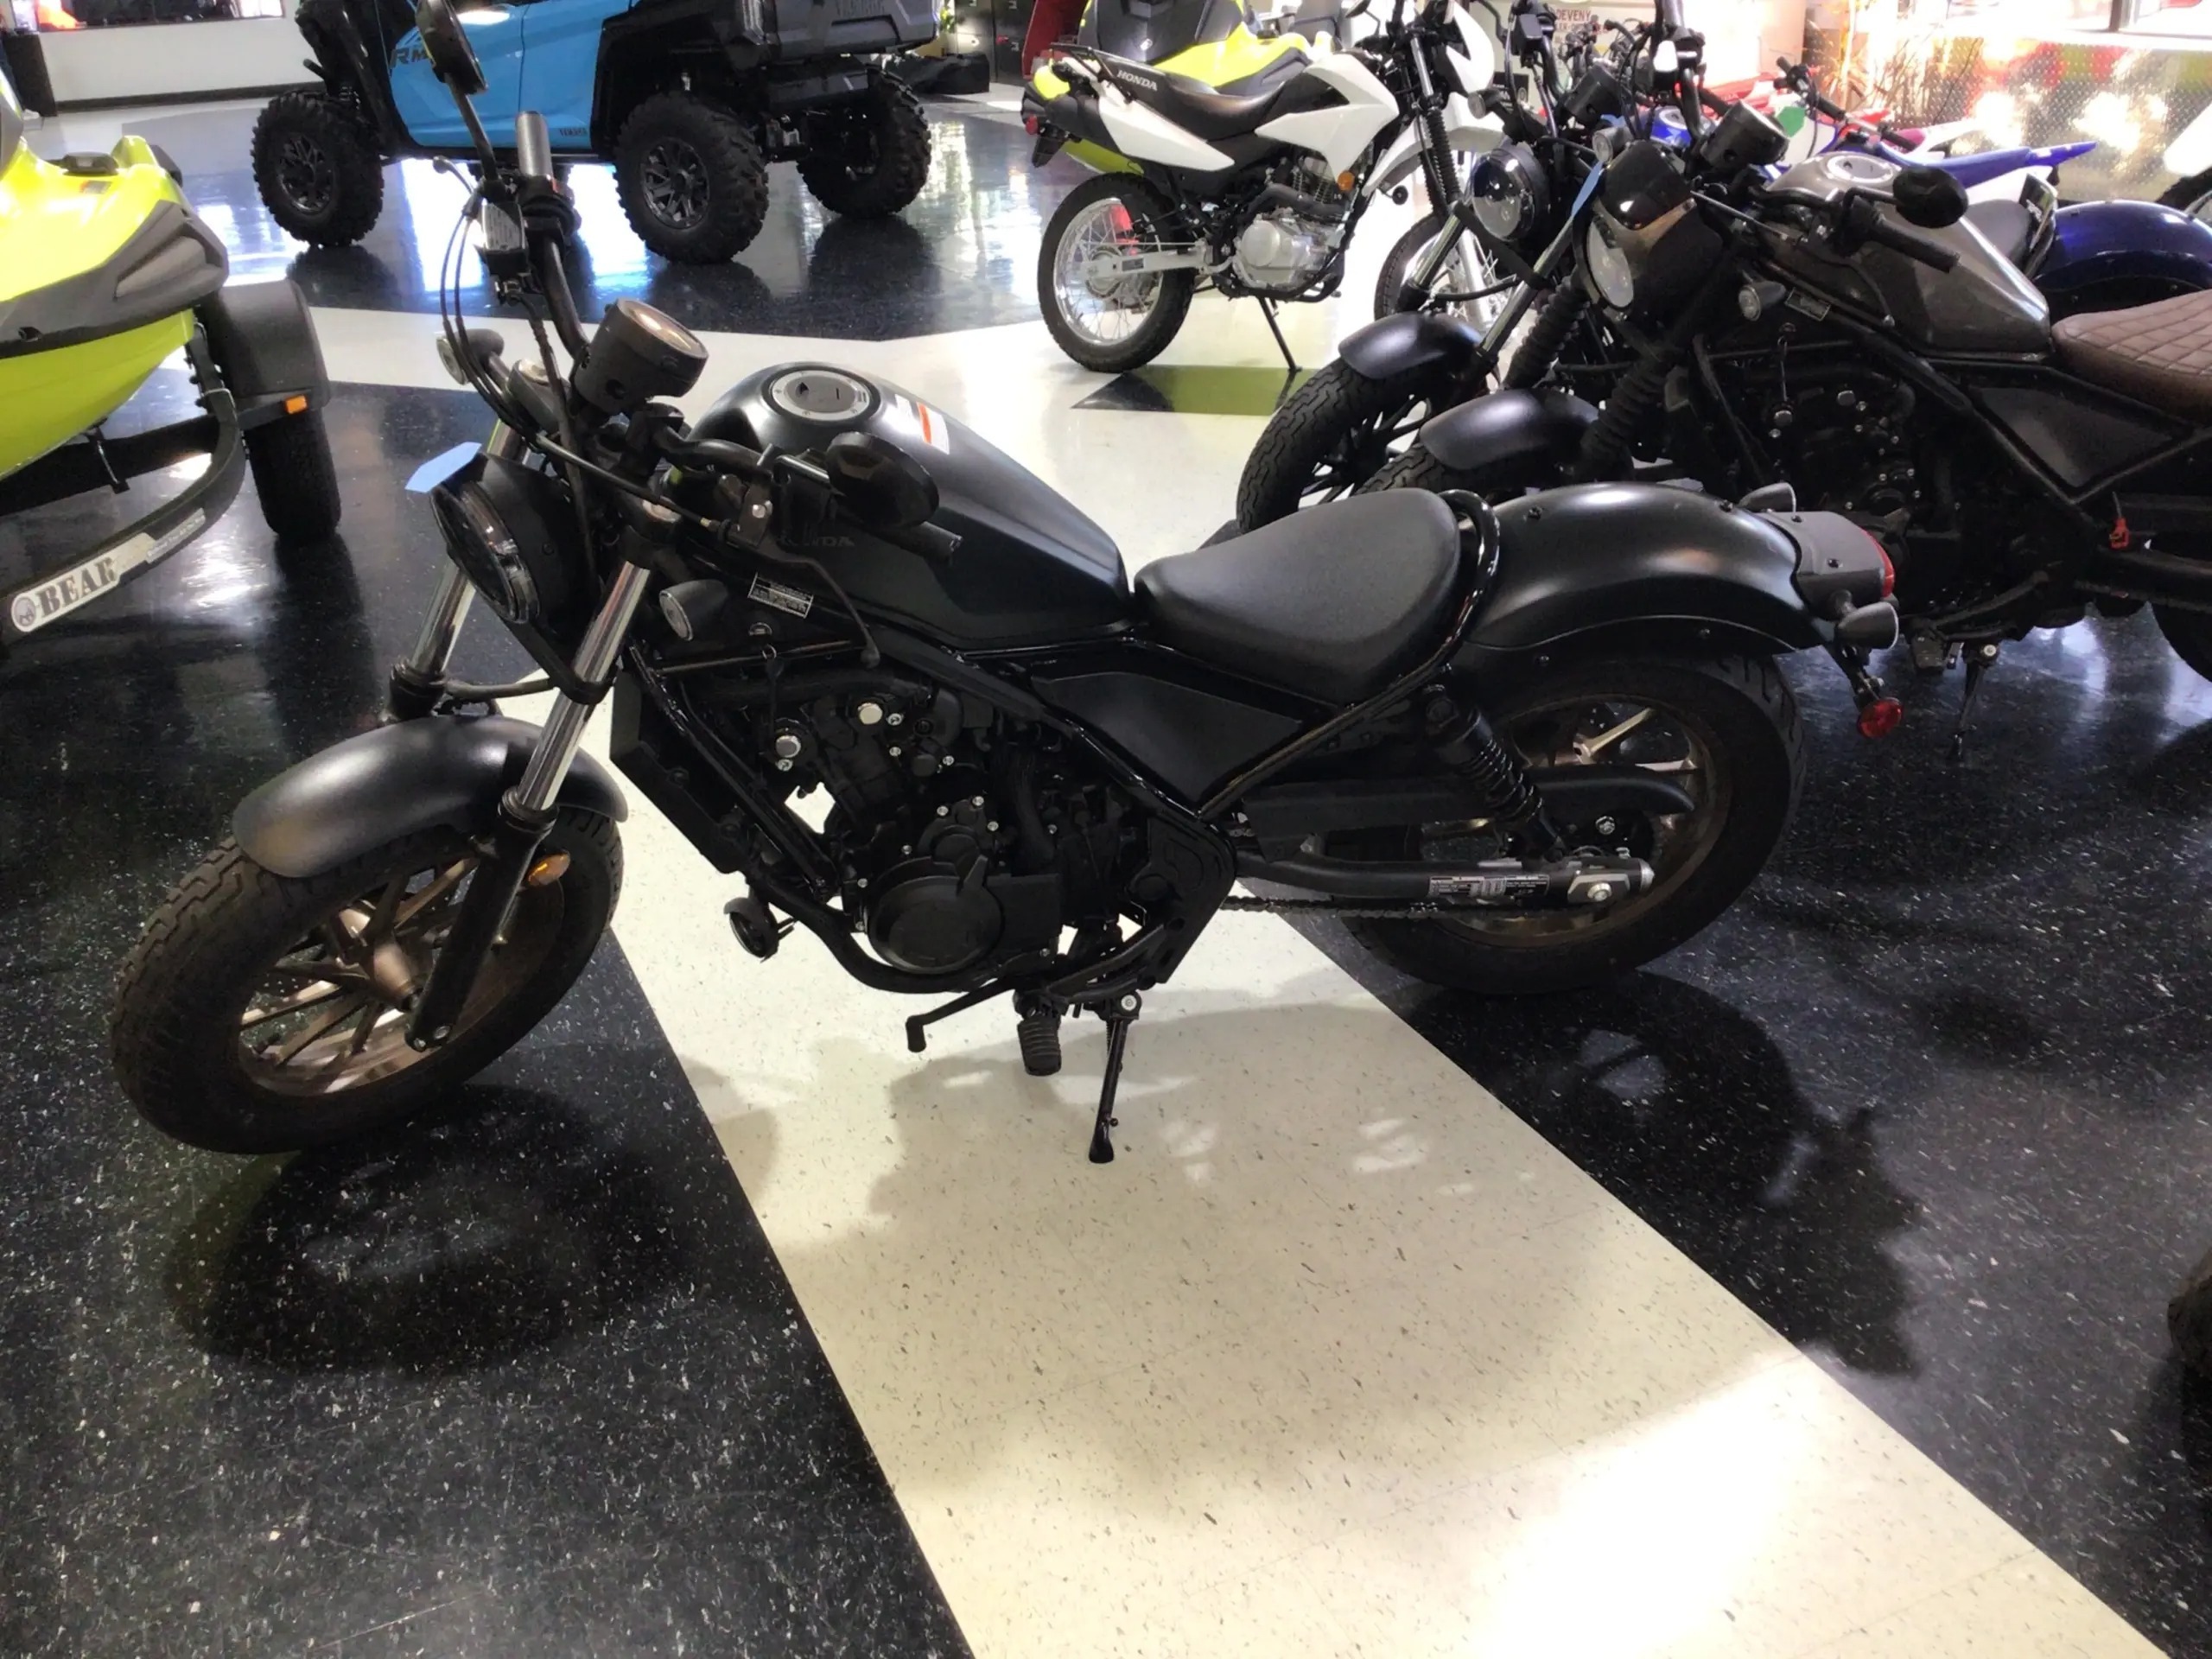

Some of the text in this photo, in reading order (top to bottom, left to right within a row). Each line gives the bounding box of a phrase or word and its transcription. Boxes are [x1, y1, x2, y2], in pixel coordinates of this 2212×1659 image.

[1556, 9, 1592, 22] DEVENY
[1116, 69, 1158, 92] HONDA
[36, 556, 118, 618] BEAR
